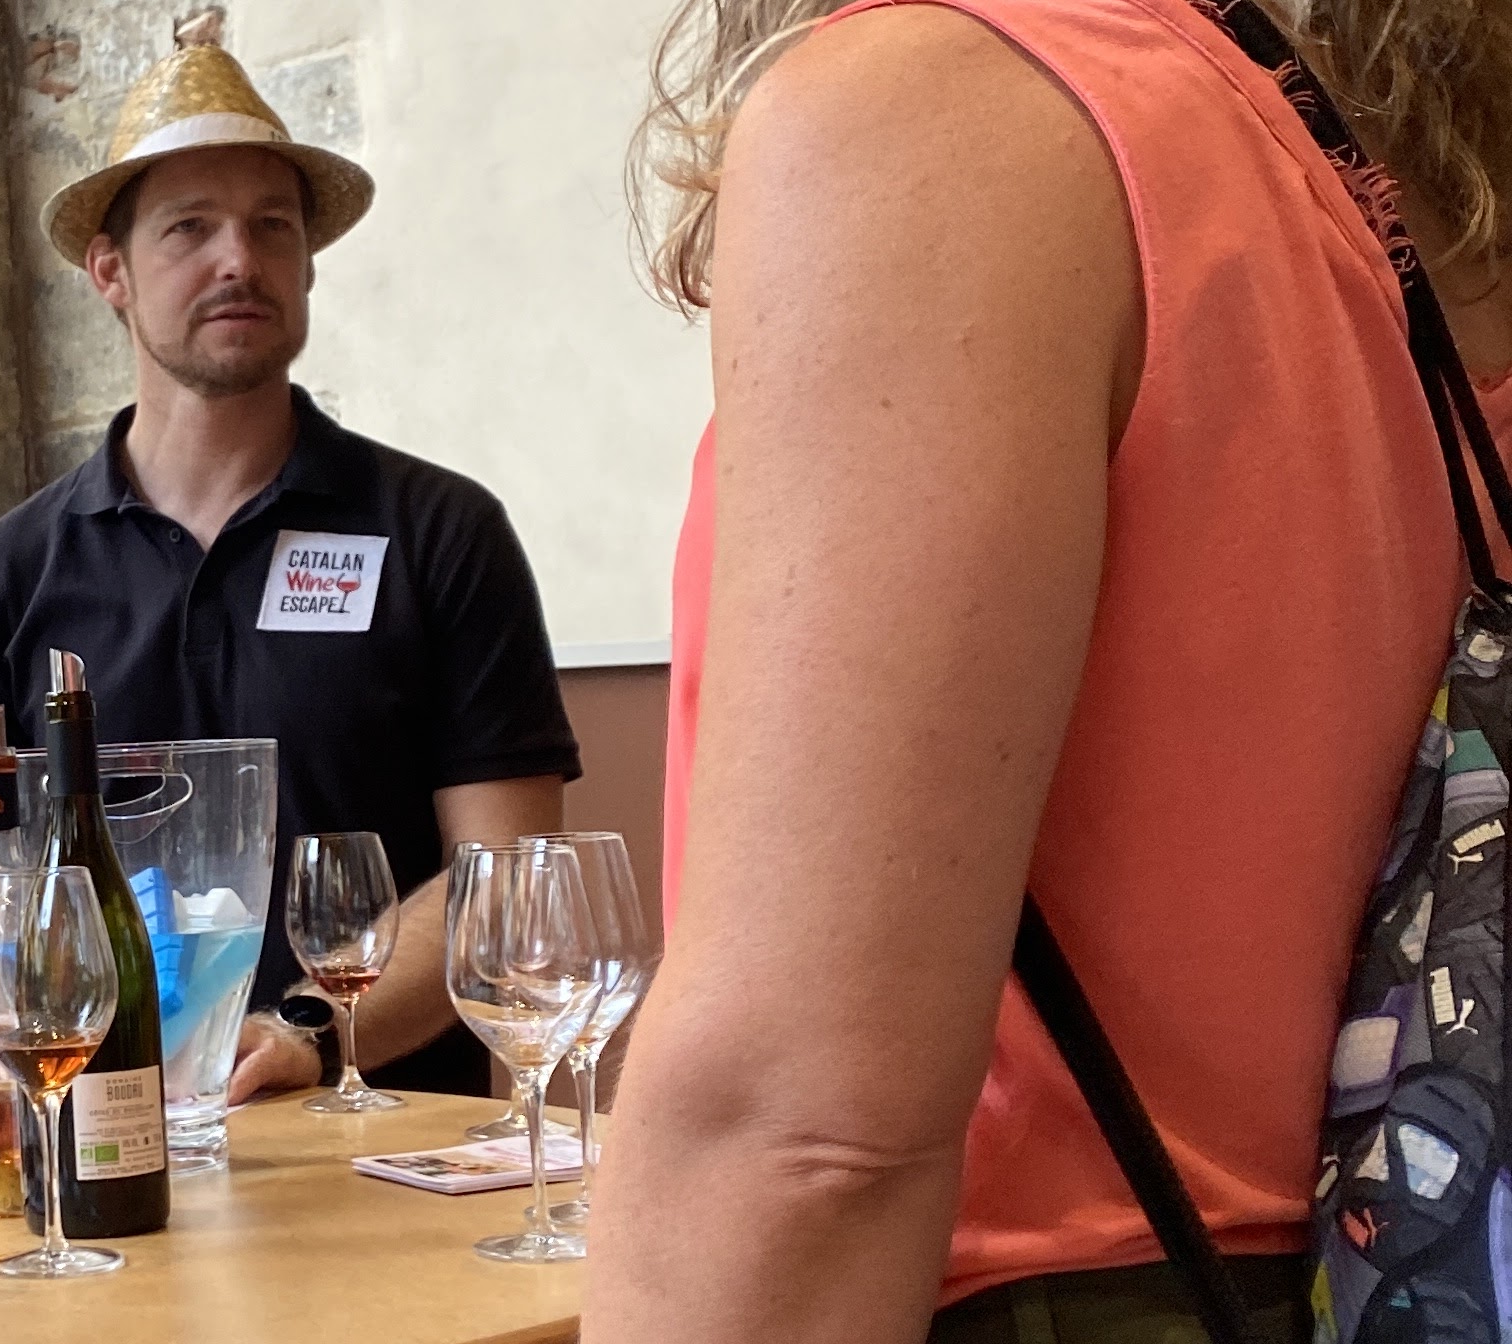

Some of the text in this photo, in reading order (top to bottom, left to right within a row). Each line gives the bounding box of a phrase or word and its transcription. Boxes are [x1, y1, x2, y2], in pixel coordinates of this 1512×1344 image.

[288, 550, 365, 571] CATALAN
[286, 570, 335, 593] Wine
[280, 596, 340, 614] ESCAPE
